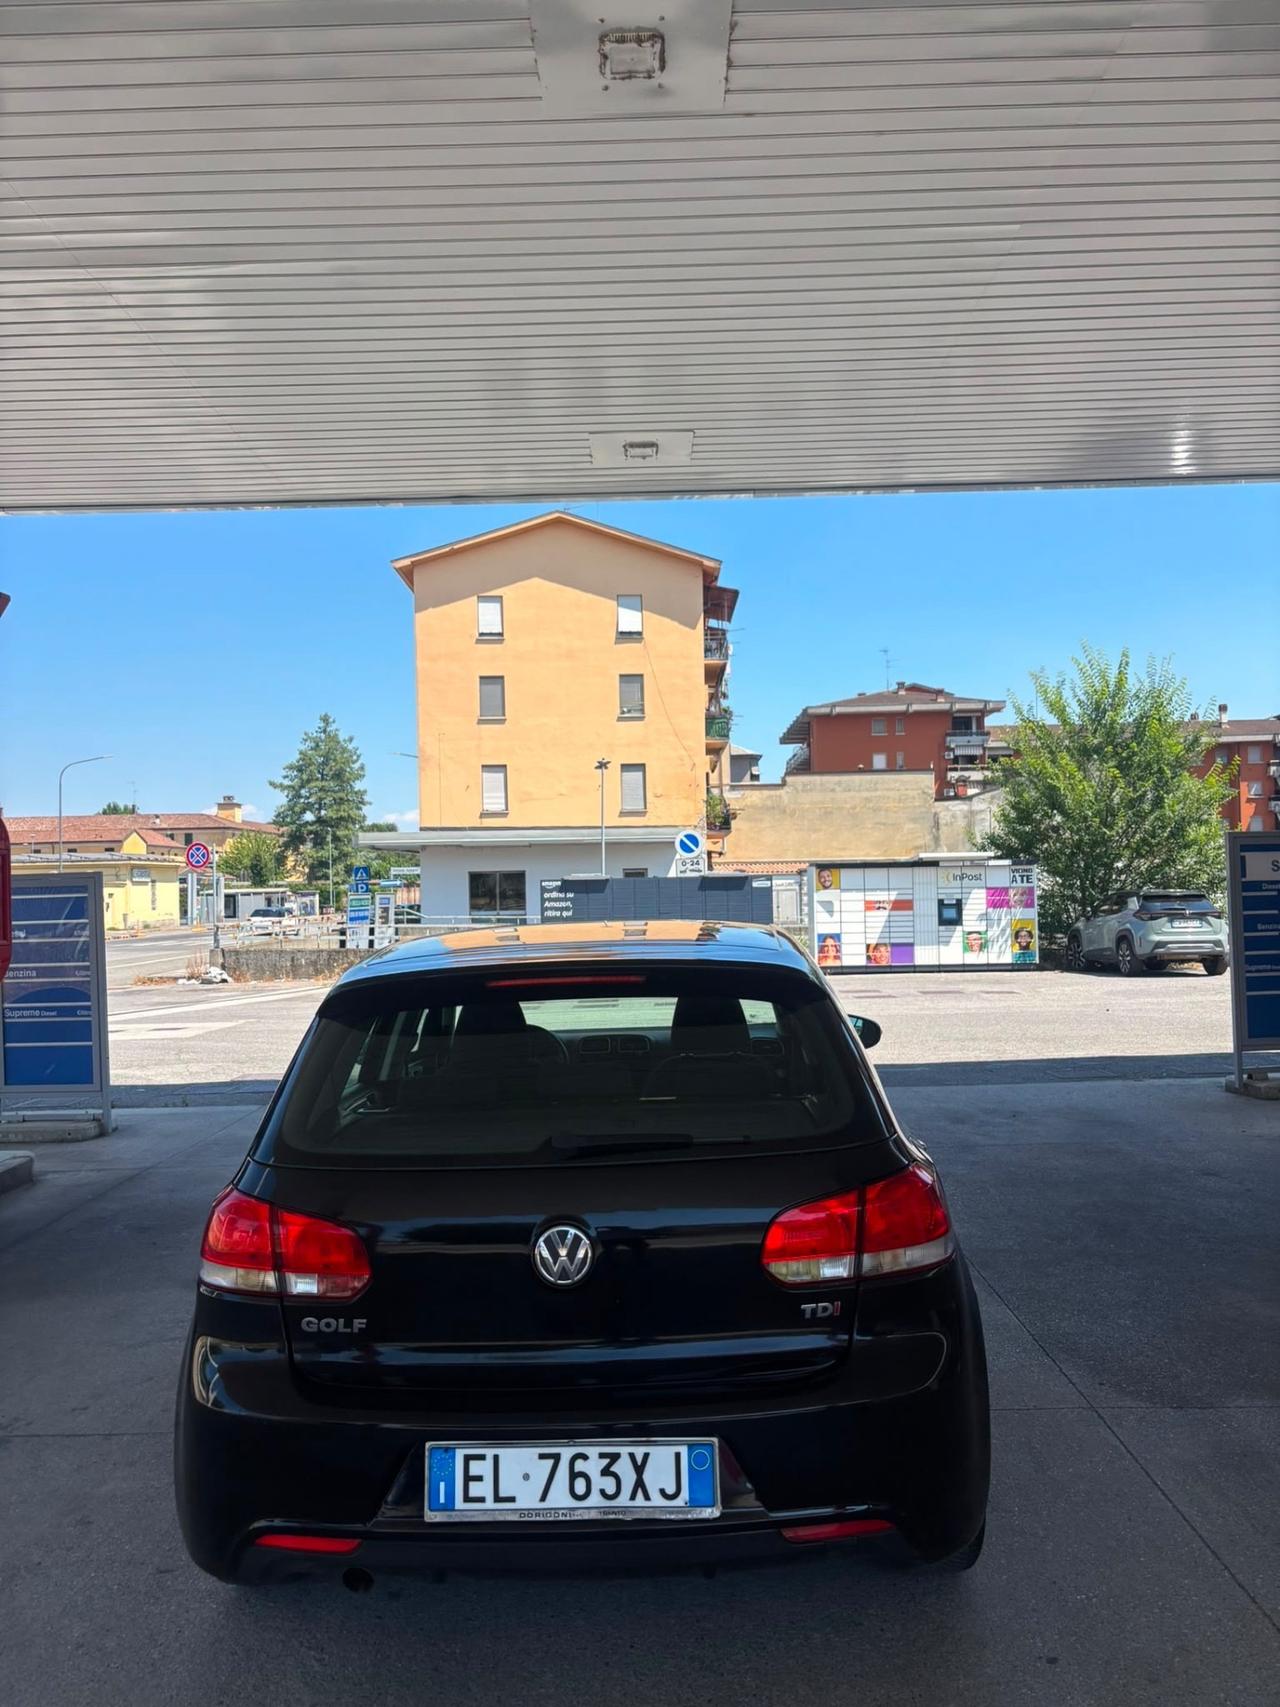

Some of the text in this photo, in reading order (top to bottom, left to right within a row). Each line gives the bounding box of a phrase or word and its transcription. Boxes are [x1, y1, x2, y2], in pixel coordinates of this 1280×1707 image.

[953, 872, 983, 882] InPost
[1011, 874, 1033, 884] A TE
[543, 891, 565, 899] ordina
[544, 909, 573, 918] ritira qui
[800, 1301, 841, 1319] TDI
[300, 1316, 368, 1333] GOLF
